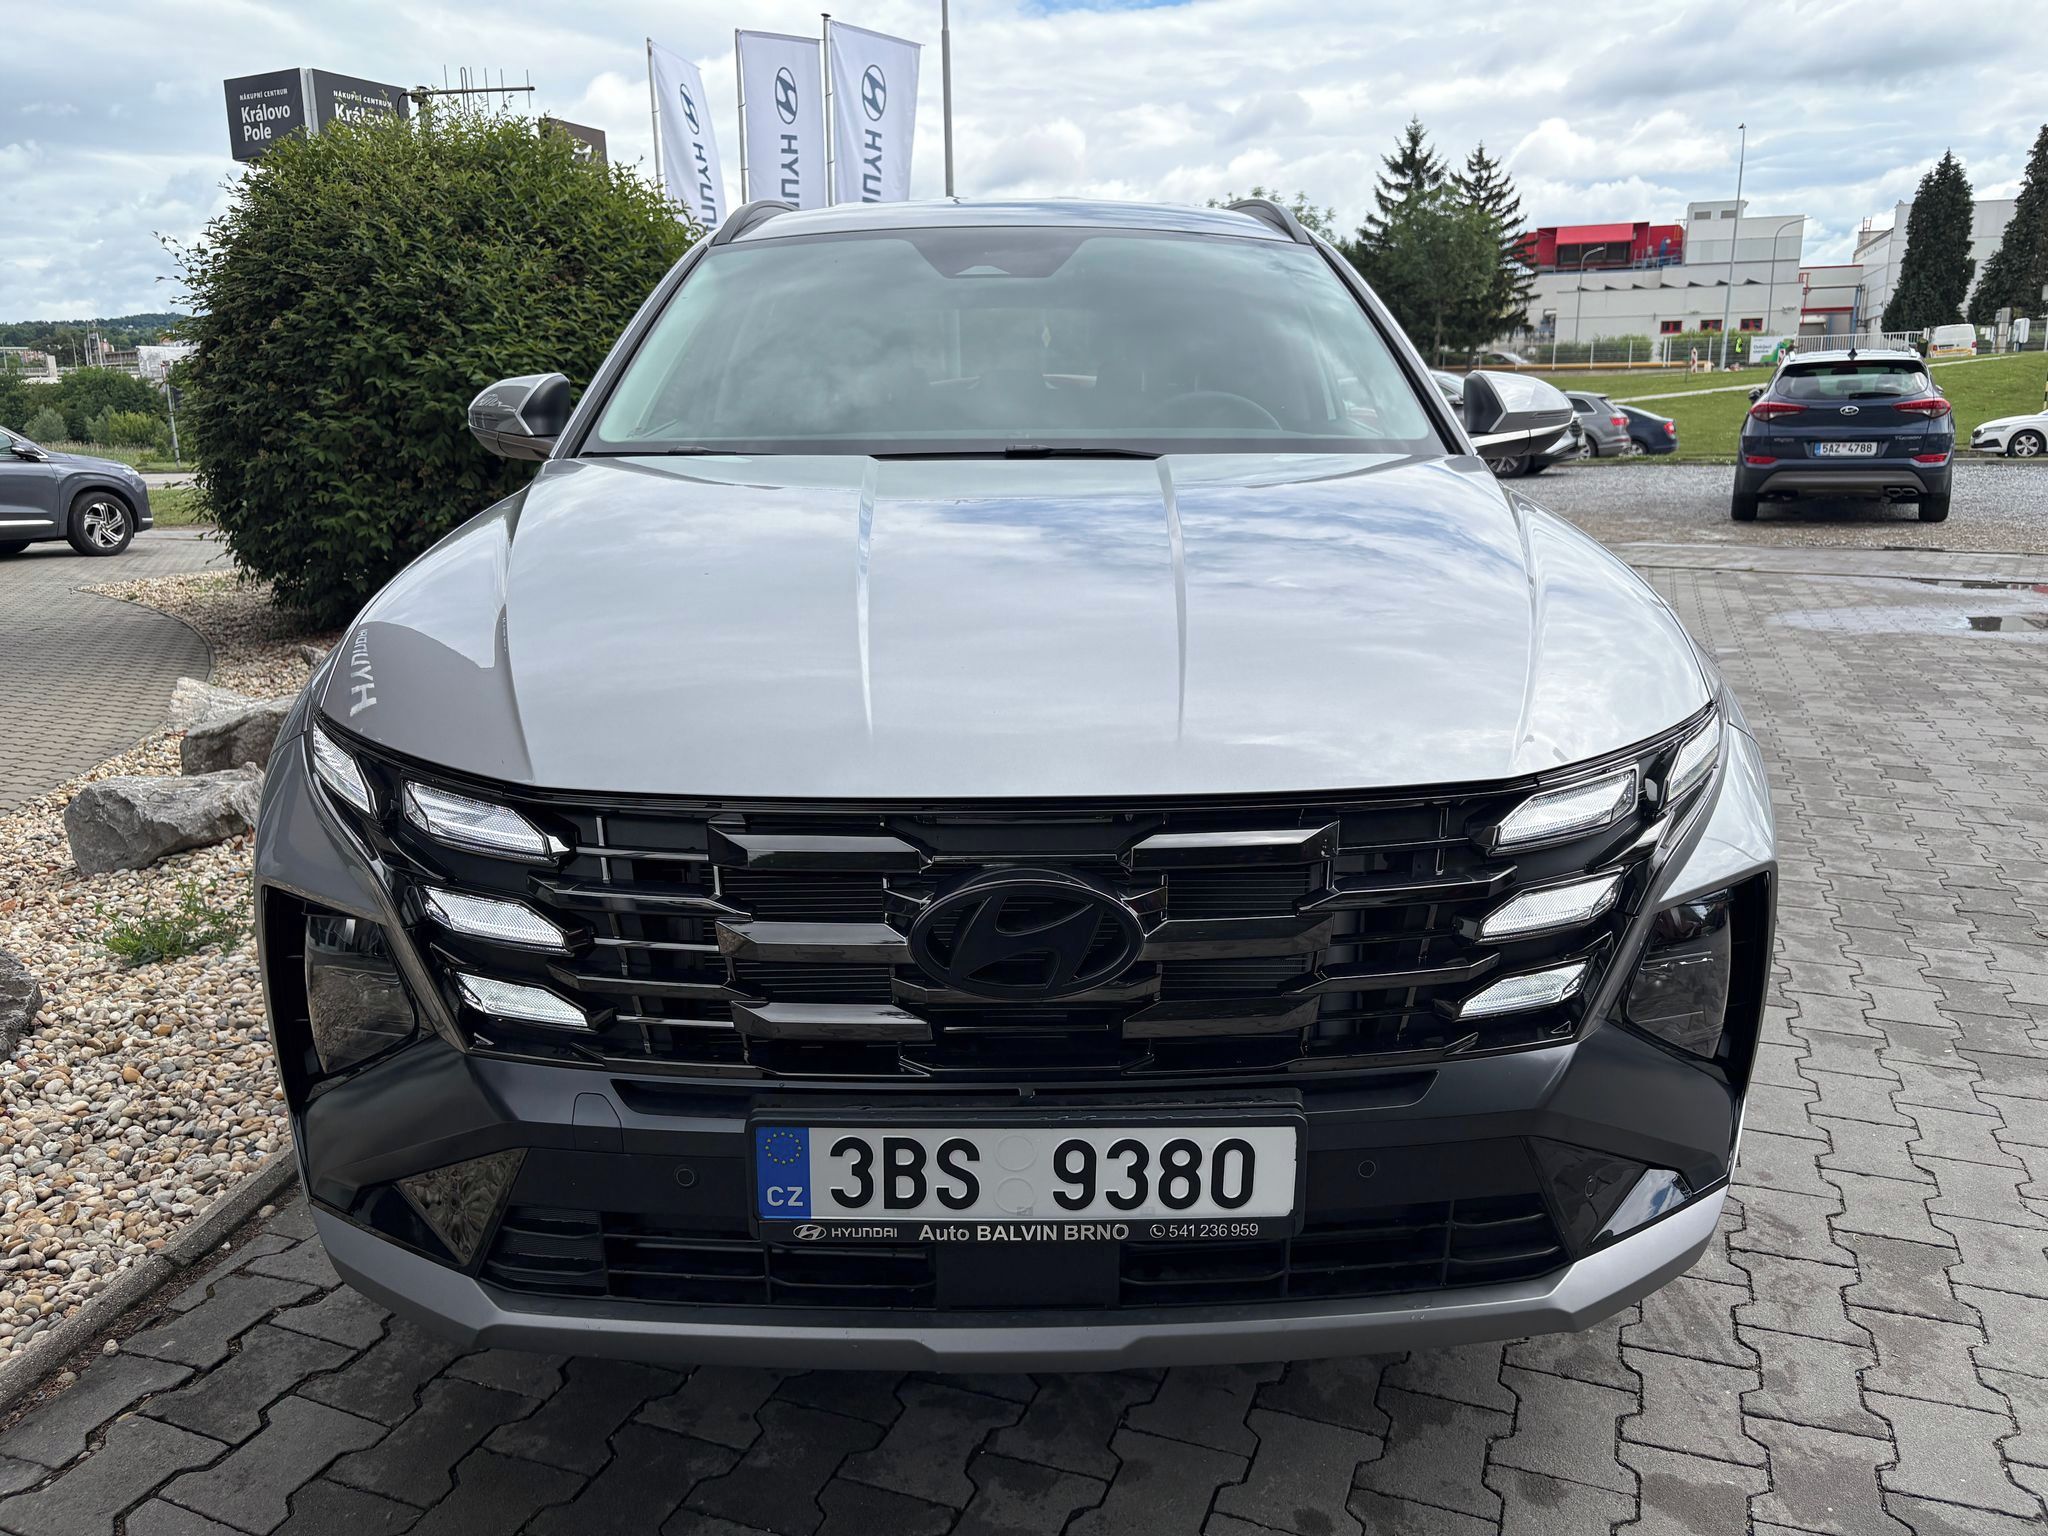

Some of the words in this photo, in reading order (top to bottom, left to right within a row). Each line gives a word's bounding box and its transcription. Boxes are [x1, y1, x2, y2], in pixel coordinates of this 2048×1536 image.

[264, 88, 288, 98] CENTRUM
[241, 103, 290, 124] Královo
[243, 122, 272, 142] Pole
[780, 134, 800, 208] HYU
[862, 129, 882, 204] HYU
[692, 142, 717, 231] HYUN
[1822, 443, 1841, 454] 5AZ
[829, 1136, 981, 1211] 3BS
[1051, 1138, 1256, 1211] 9380
[766, 1186, 804, 1208] CZ
[831, 1227, 898, 1238] HYUNDAI
[918, 1224, 970, 1241] Auto
[976, 1224, 1057, 1241] BALVIN
[1063, 1223, 1129, 1241] BRNO
[1168, 1224, 1196, 1238] 541
[1199, 1223, 1228, 1237] 236
[1230, 1222, 1259, 1237] 959
